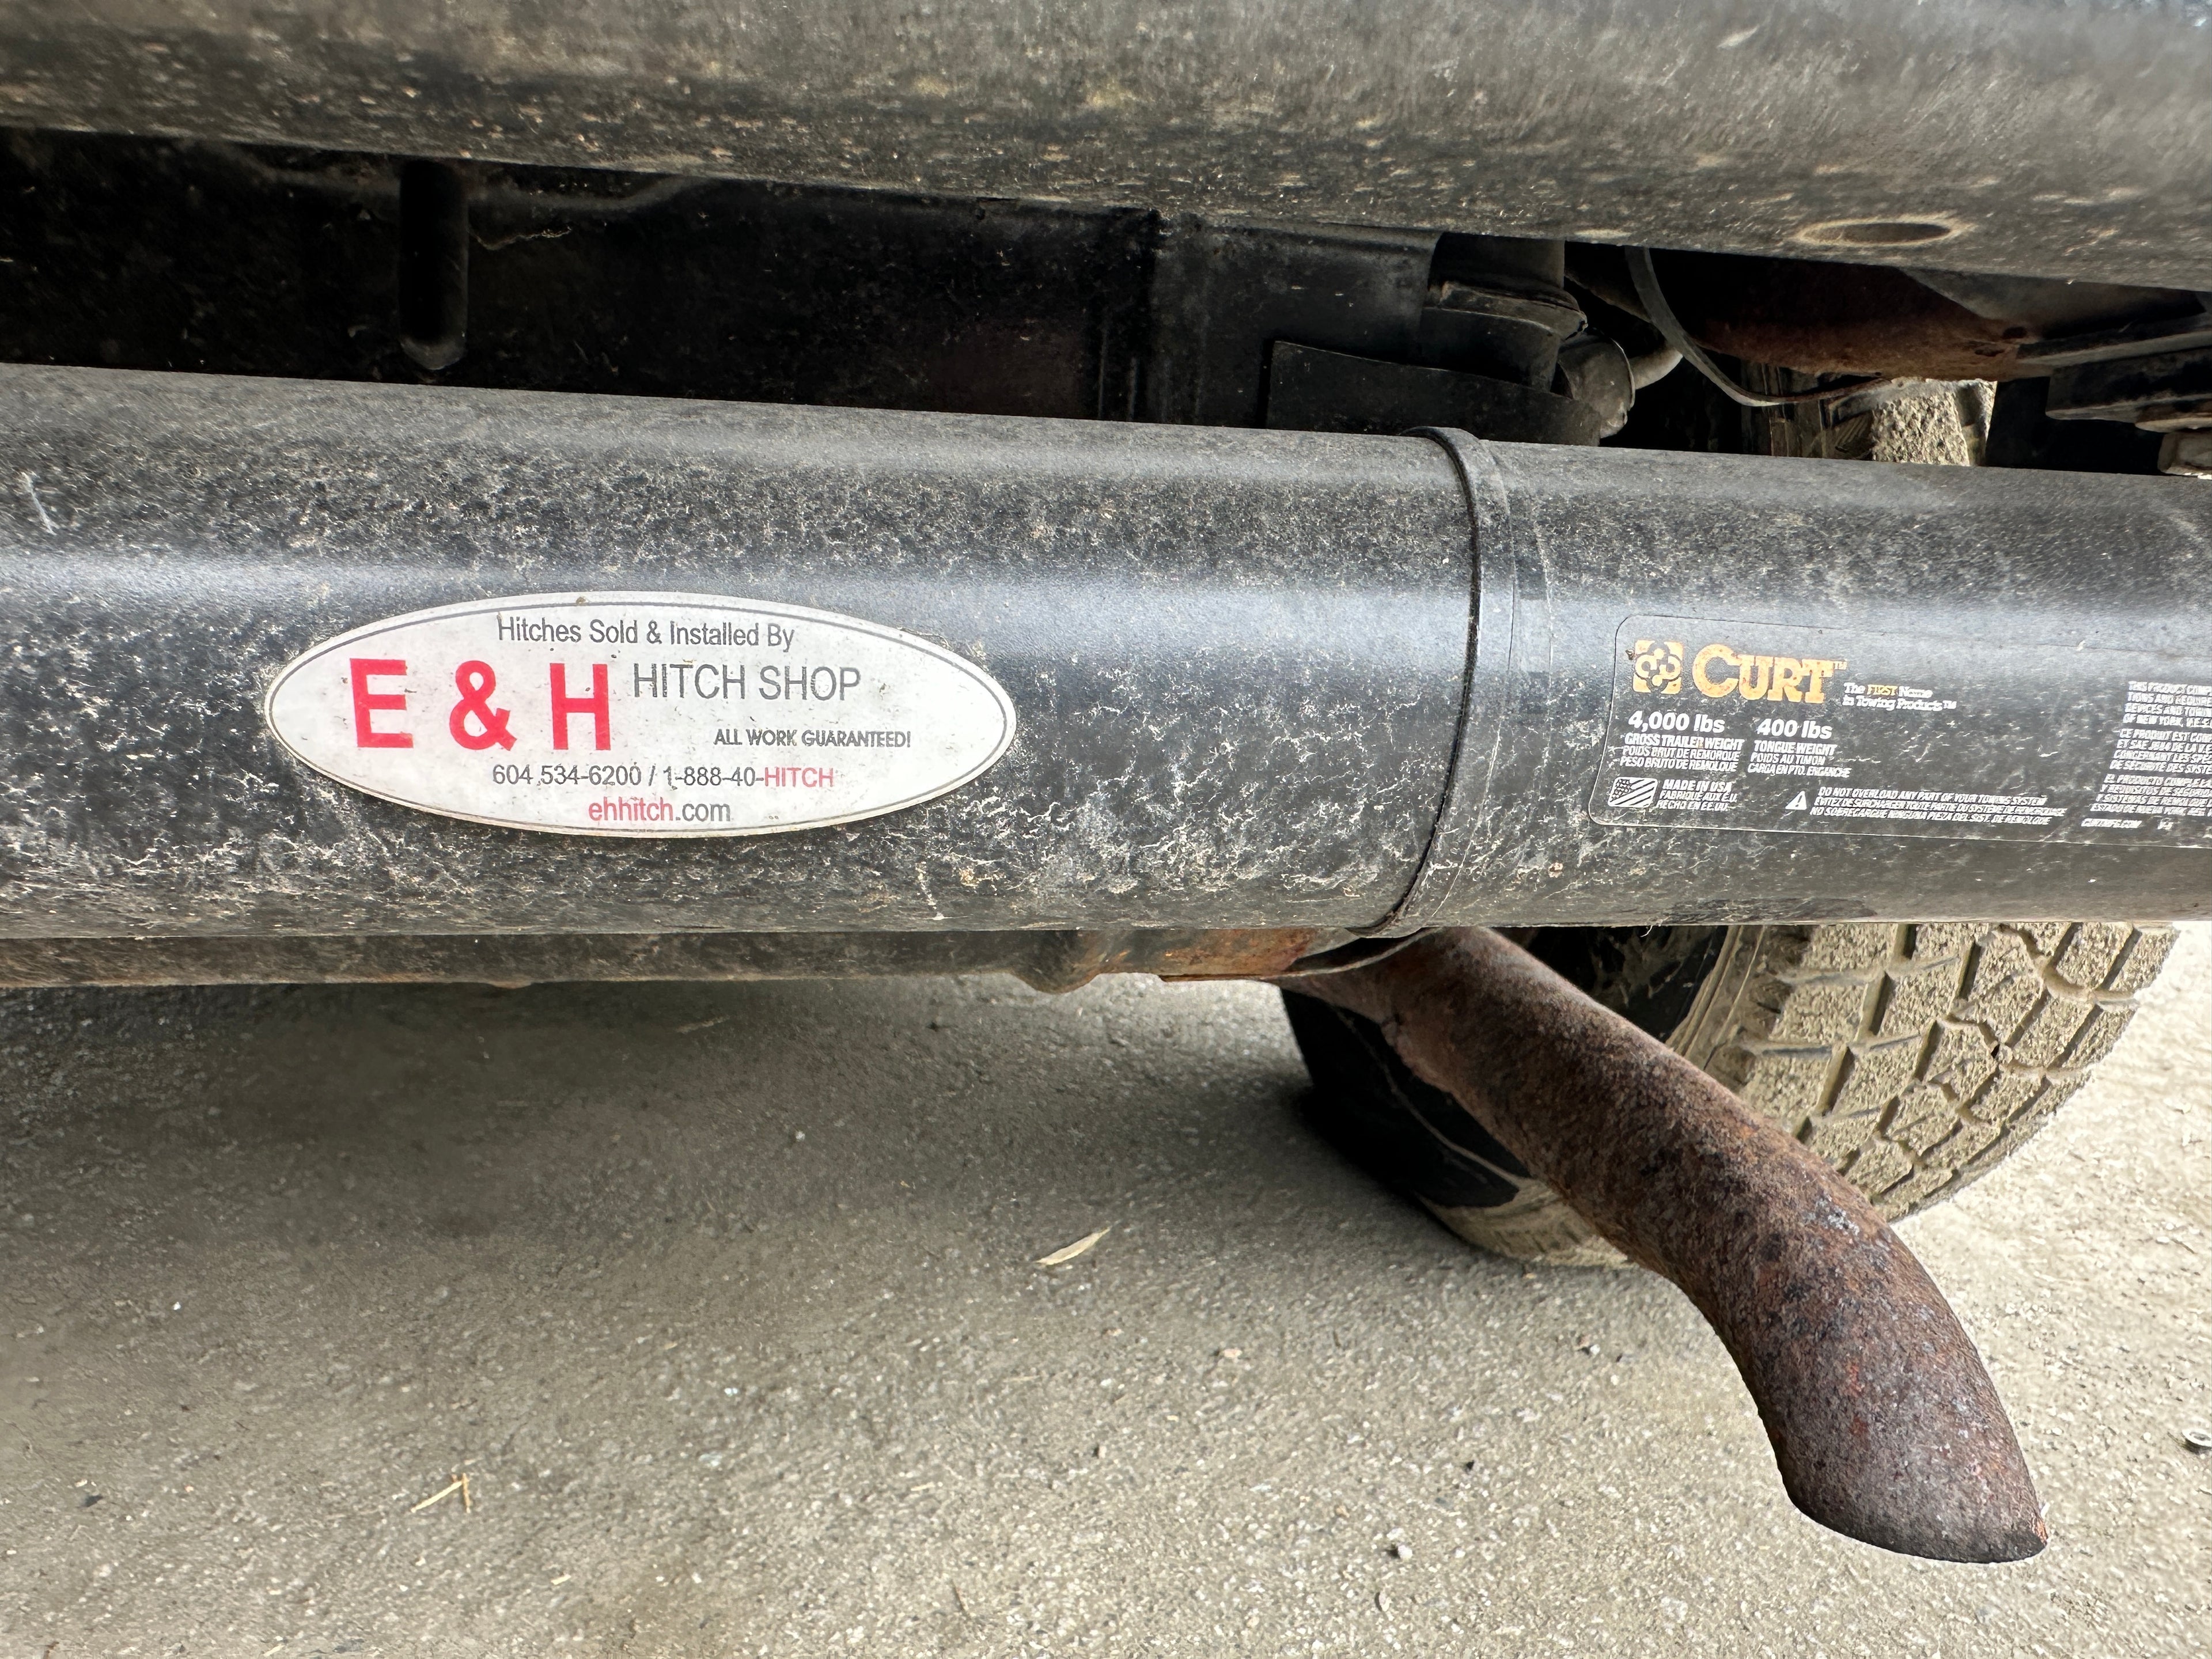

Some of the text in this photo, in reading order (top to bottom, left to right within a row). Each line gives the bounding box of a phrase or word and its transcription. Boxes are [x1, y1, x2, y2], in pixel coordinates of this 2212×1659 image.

[497, 616, 795, 652] Hitches Sold & Installed By
[1843, 682, 1866, 694] The
[350, 658, 861, 751] E & H HITCH SHOP
[1855, 695, 1896, 711] Towing
[1627, 710, 1726, 733] 4,000 lbs
[1756, 718, 1833, 740] 400 lbs
[713, 728, 911, 748] ALL WORK GUARANTEED!
[1624, 732, 1745, 751] GROSS TRAILER WEIGHT
[1676, 748, 1690, 759] DE
[1689, 749, 1740, 762] REMORQUE
[1754, 740, 1838, 756] TONGUE WEIGHT
[1620, 756, 1643, 767] PESO
[1644, 757, 1675, 769] BRUTO
[1750, 752, 1779, 763] POIDS
[1779, 754, 1796, 765] AU
[648, 763, 656, 786] /
[663, 765, 834, 787] 1-888-40-HITCH
[1662, 779, 1733, 793] MADE IN USA
[1818, 787, 1832, 797] DO
[1832, 787, 1853, 798] NOT
[1851, 789, 1899, 800] OVERLOAD
[588, 796, 731, 822] ehhitch.com
